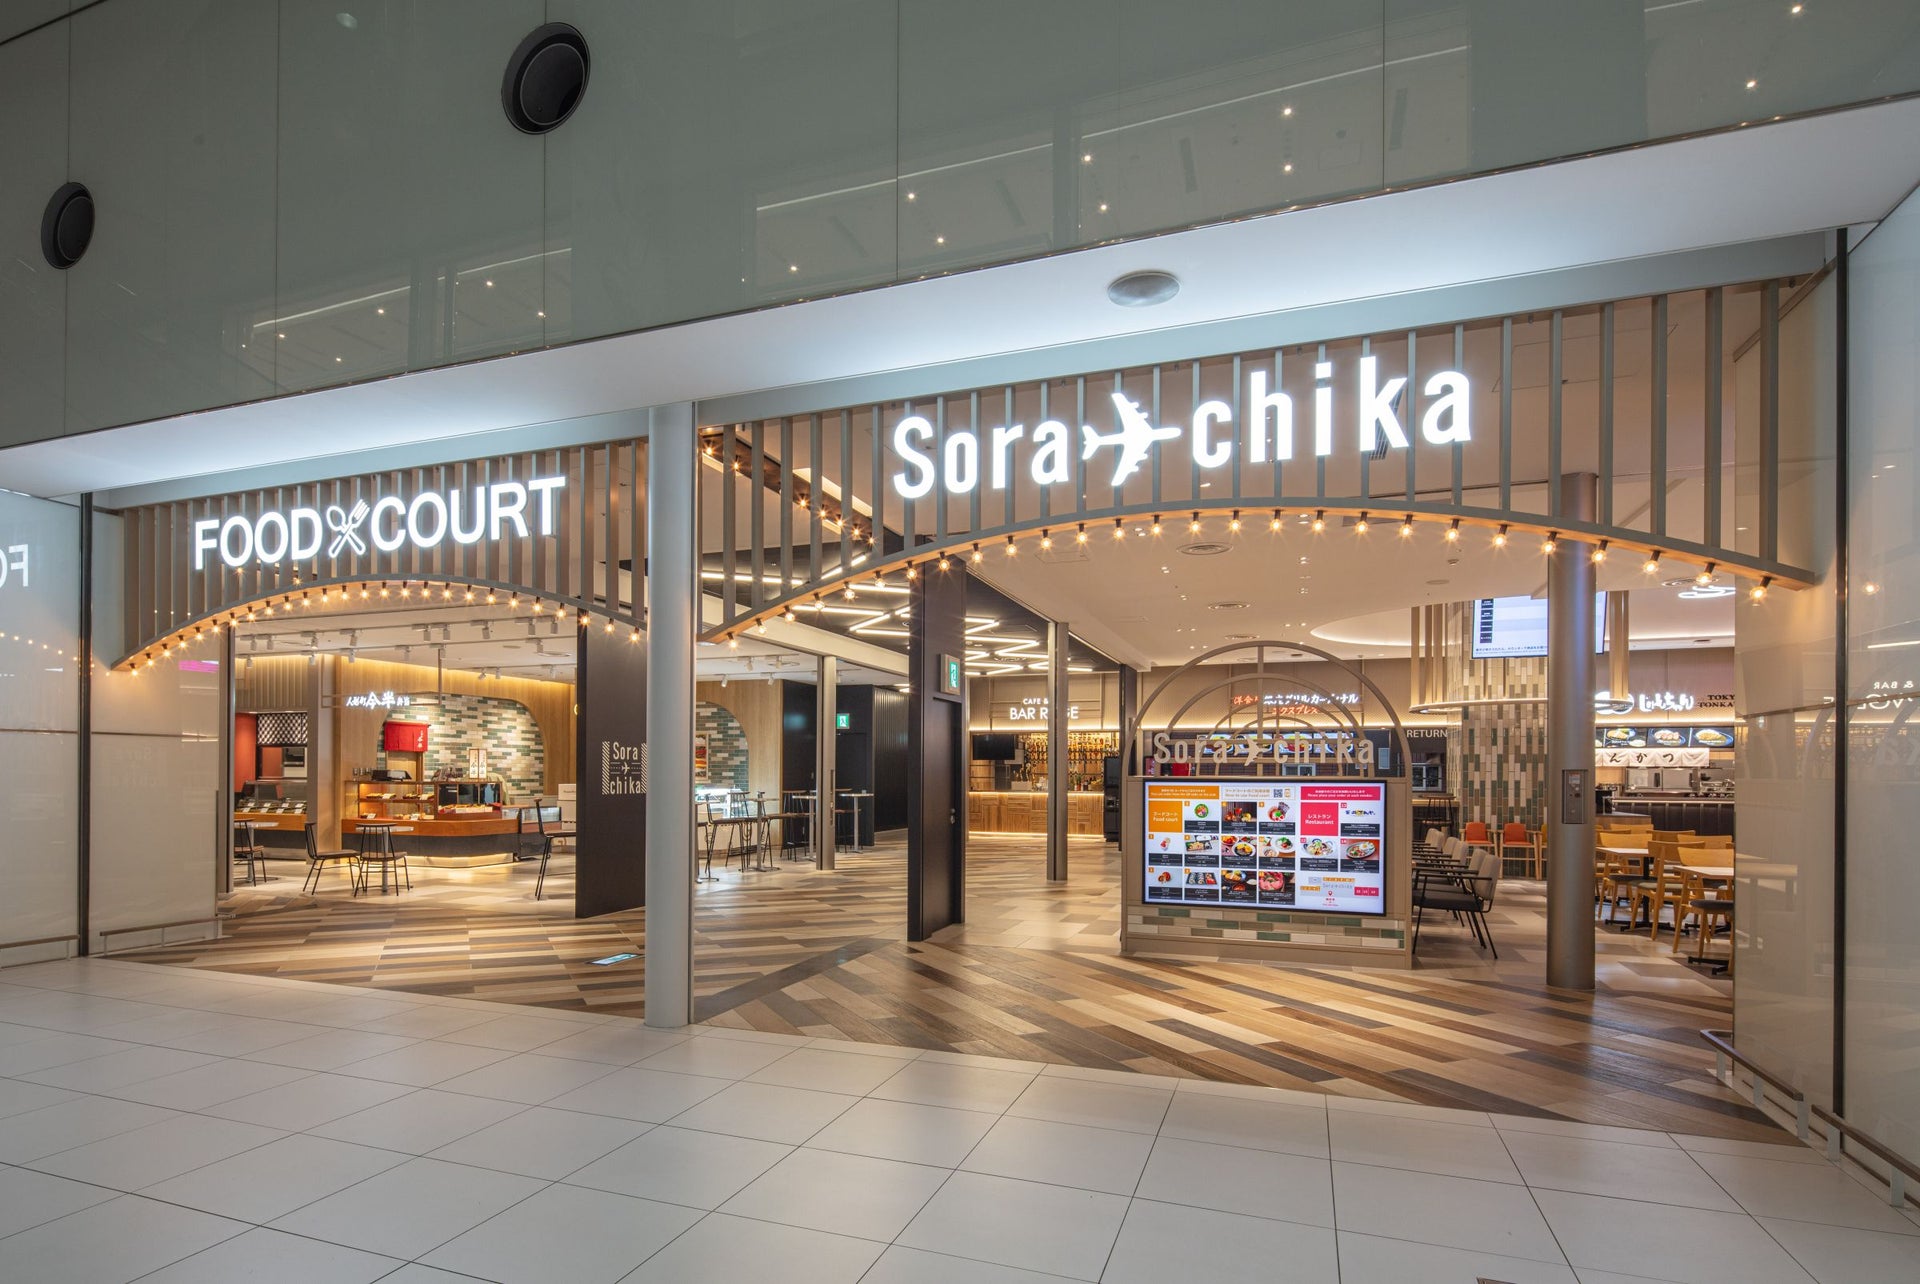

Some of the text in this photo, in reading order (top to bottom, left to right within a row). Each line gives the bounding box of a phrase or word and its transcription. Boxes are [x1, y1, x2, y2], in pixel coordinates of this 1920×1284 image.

[892, 355, 1472, 499] Sora chika
[194, 475, 567, 571] FOOD COURT
[1010, 707, 1036, 720] BAR
[1406, 729, 1448, 738] RETURN
[612, 741, 639, 761] Sora
[1153, 731, 1375, 764] Sora chika
[610, 776, 641, 795] chika
